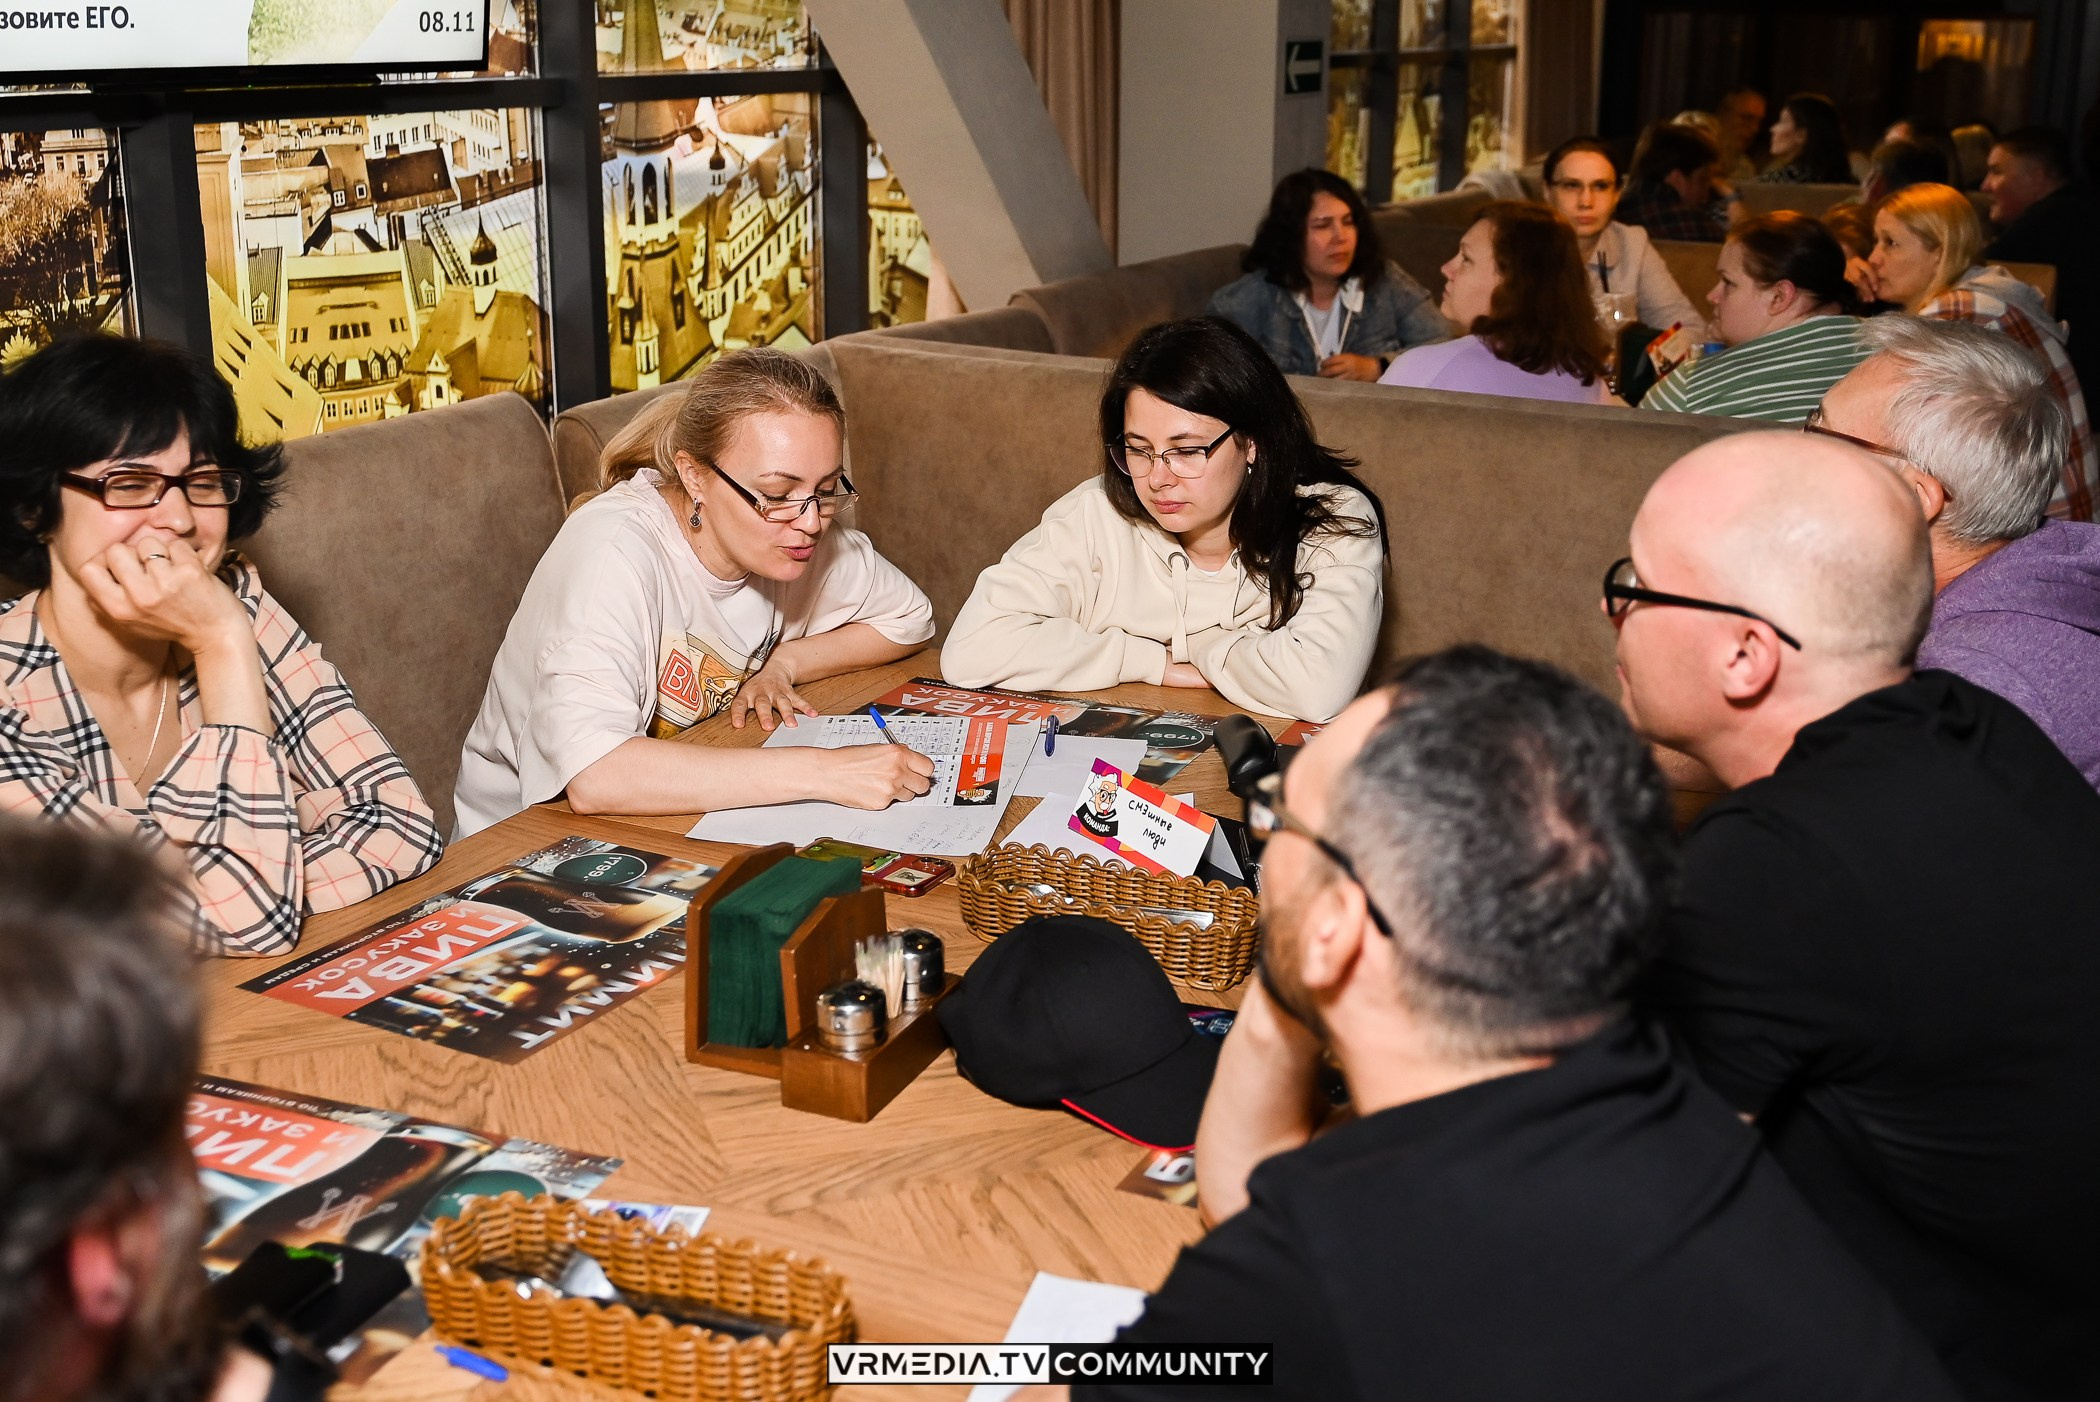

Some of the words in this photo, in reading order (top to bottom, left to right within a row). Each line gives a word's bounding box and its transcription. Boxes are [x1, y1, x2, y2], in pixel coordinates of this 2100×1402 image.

[86, 5, 135, 29] ЕГО.
[419, 11, 475, 32] 08.11
[914, 687, 1043, 709] ЗАКУСОК
[448, 907, 478, 918] И
[321, 928, 385, 958] ВТОРНИКАМ
[292, 920, 447, 991] ЗАКУСОК
[313, 914, 519, 1000] ПИВА
[264, 962, 311, 984] СРЕДАМ
[215, 1086, 297, 1108] ВТОРНИКАМ
[187, 1101, 315, 1138] ЗАКУС
[320, 1131, 359, 1147] И
[185, 1124, 329, 1178] ПИ
